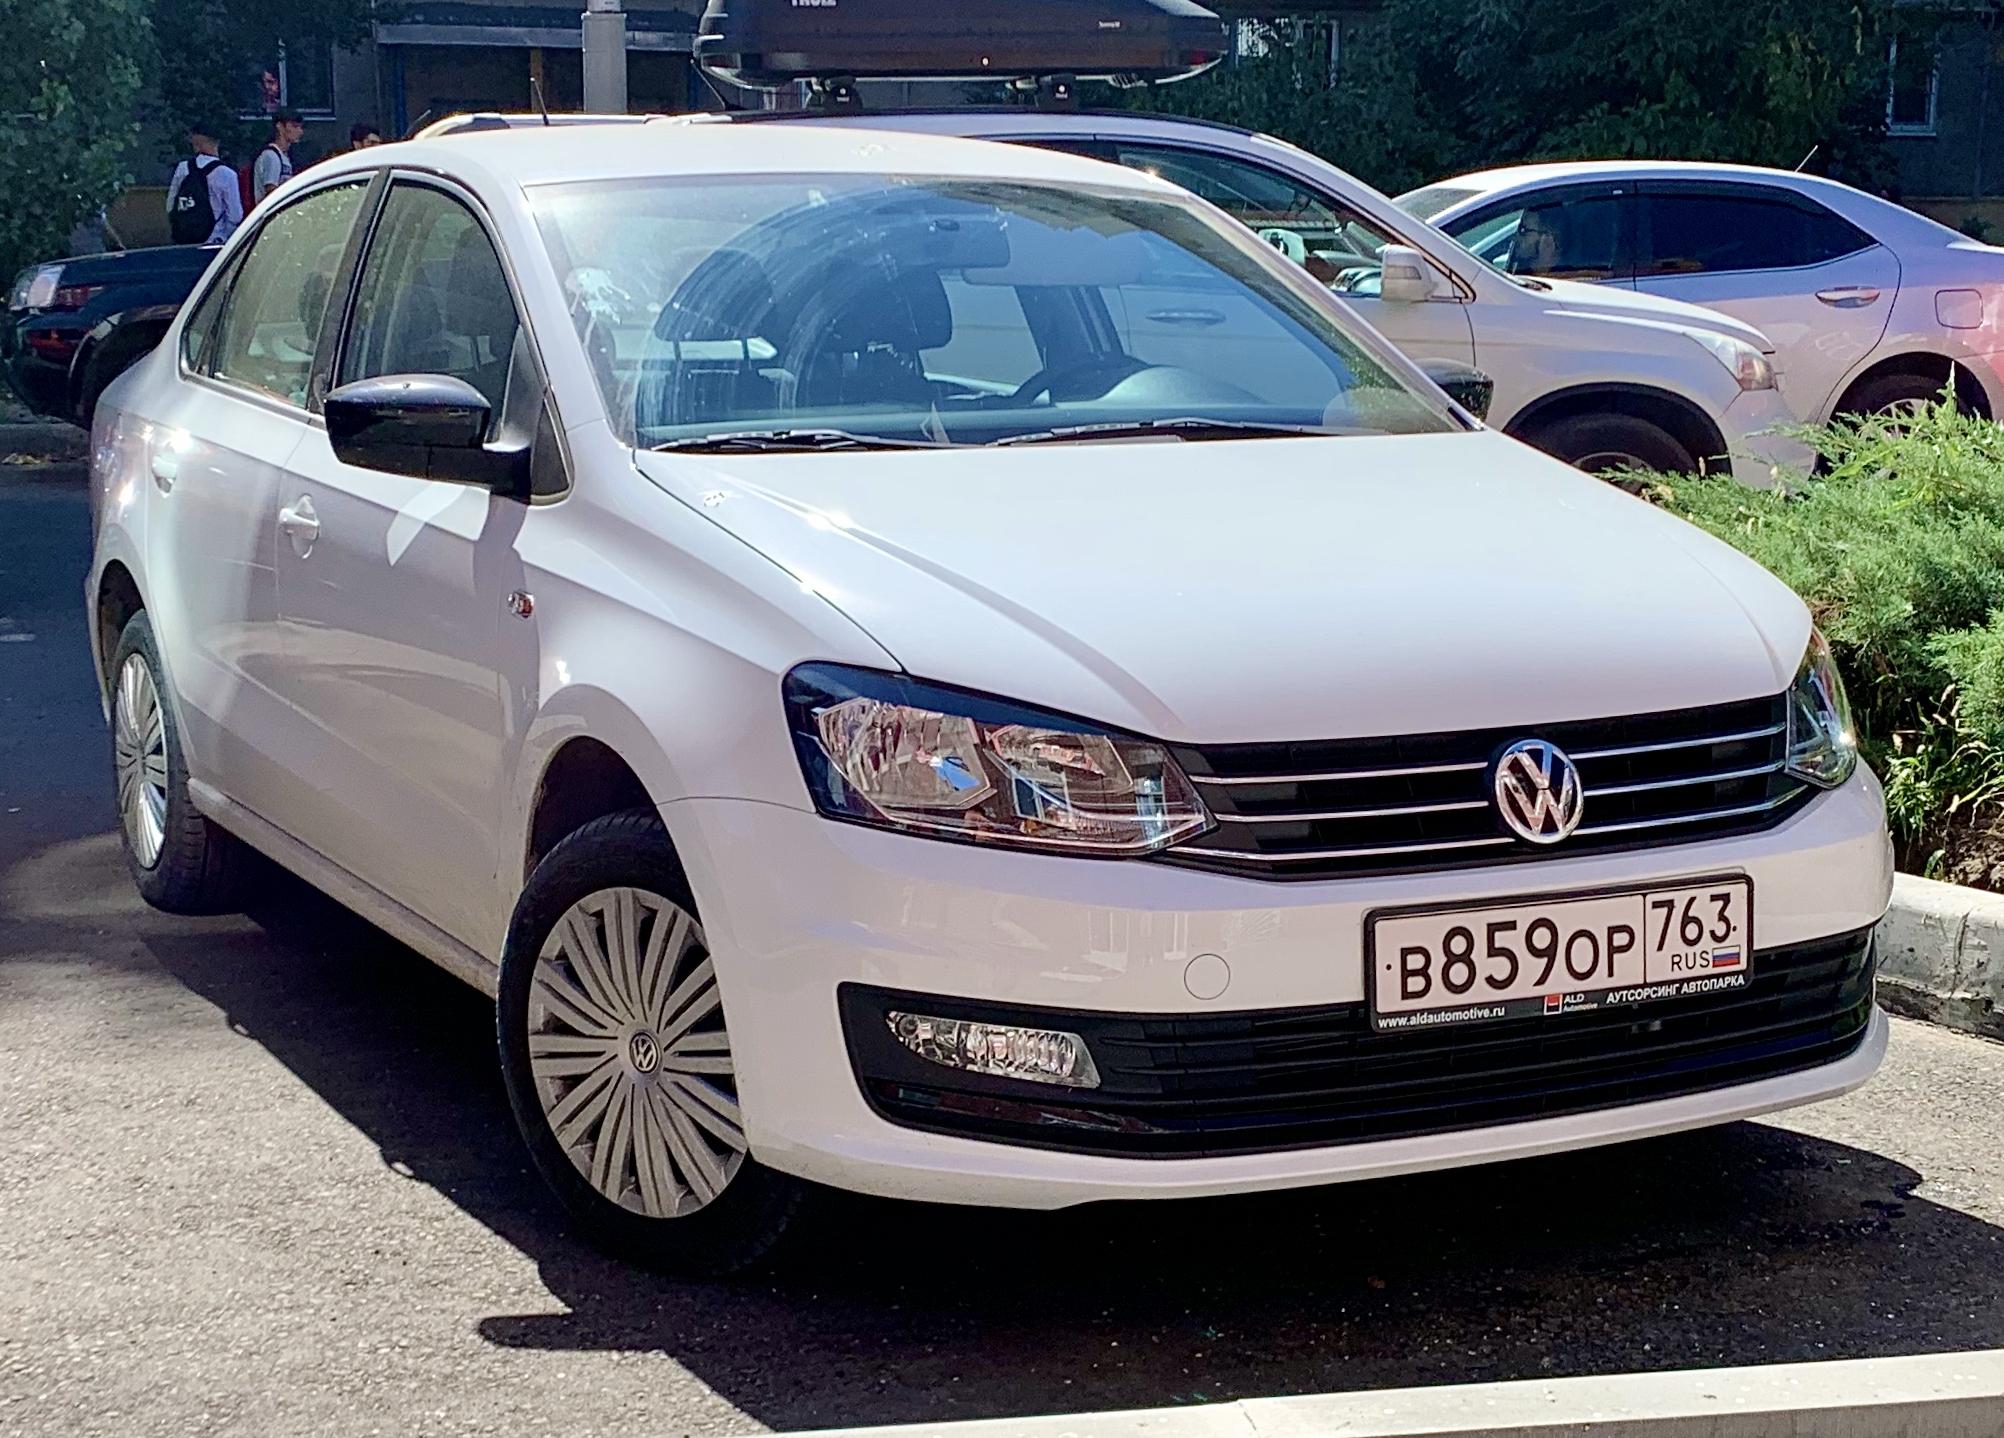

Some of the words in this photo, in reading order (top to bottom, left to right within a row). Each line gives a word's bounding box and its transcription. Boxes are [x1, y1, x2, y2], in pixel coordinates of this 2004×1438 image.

[1651, 892, 1731, 952] 763
[1671, 950, 1710, 972] RUS
[1564, 993, 1585, 1004] ALD
[1606, 983, 1680, 1004] АУТСОРСИНГ
[1681, 974, 1745, 995] АВТОПАРКА
[1378, 1006, 1505, 1029] www.aldautomotive.ru
